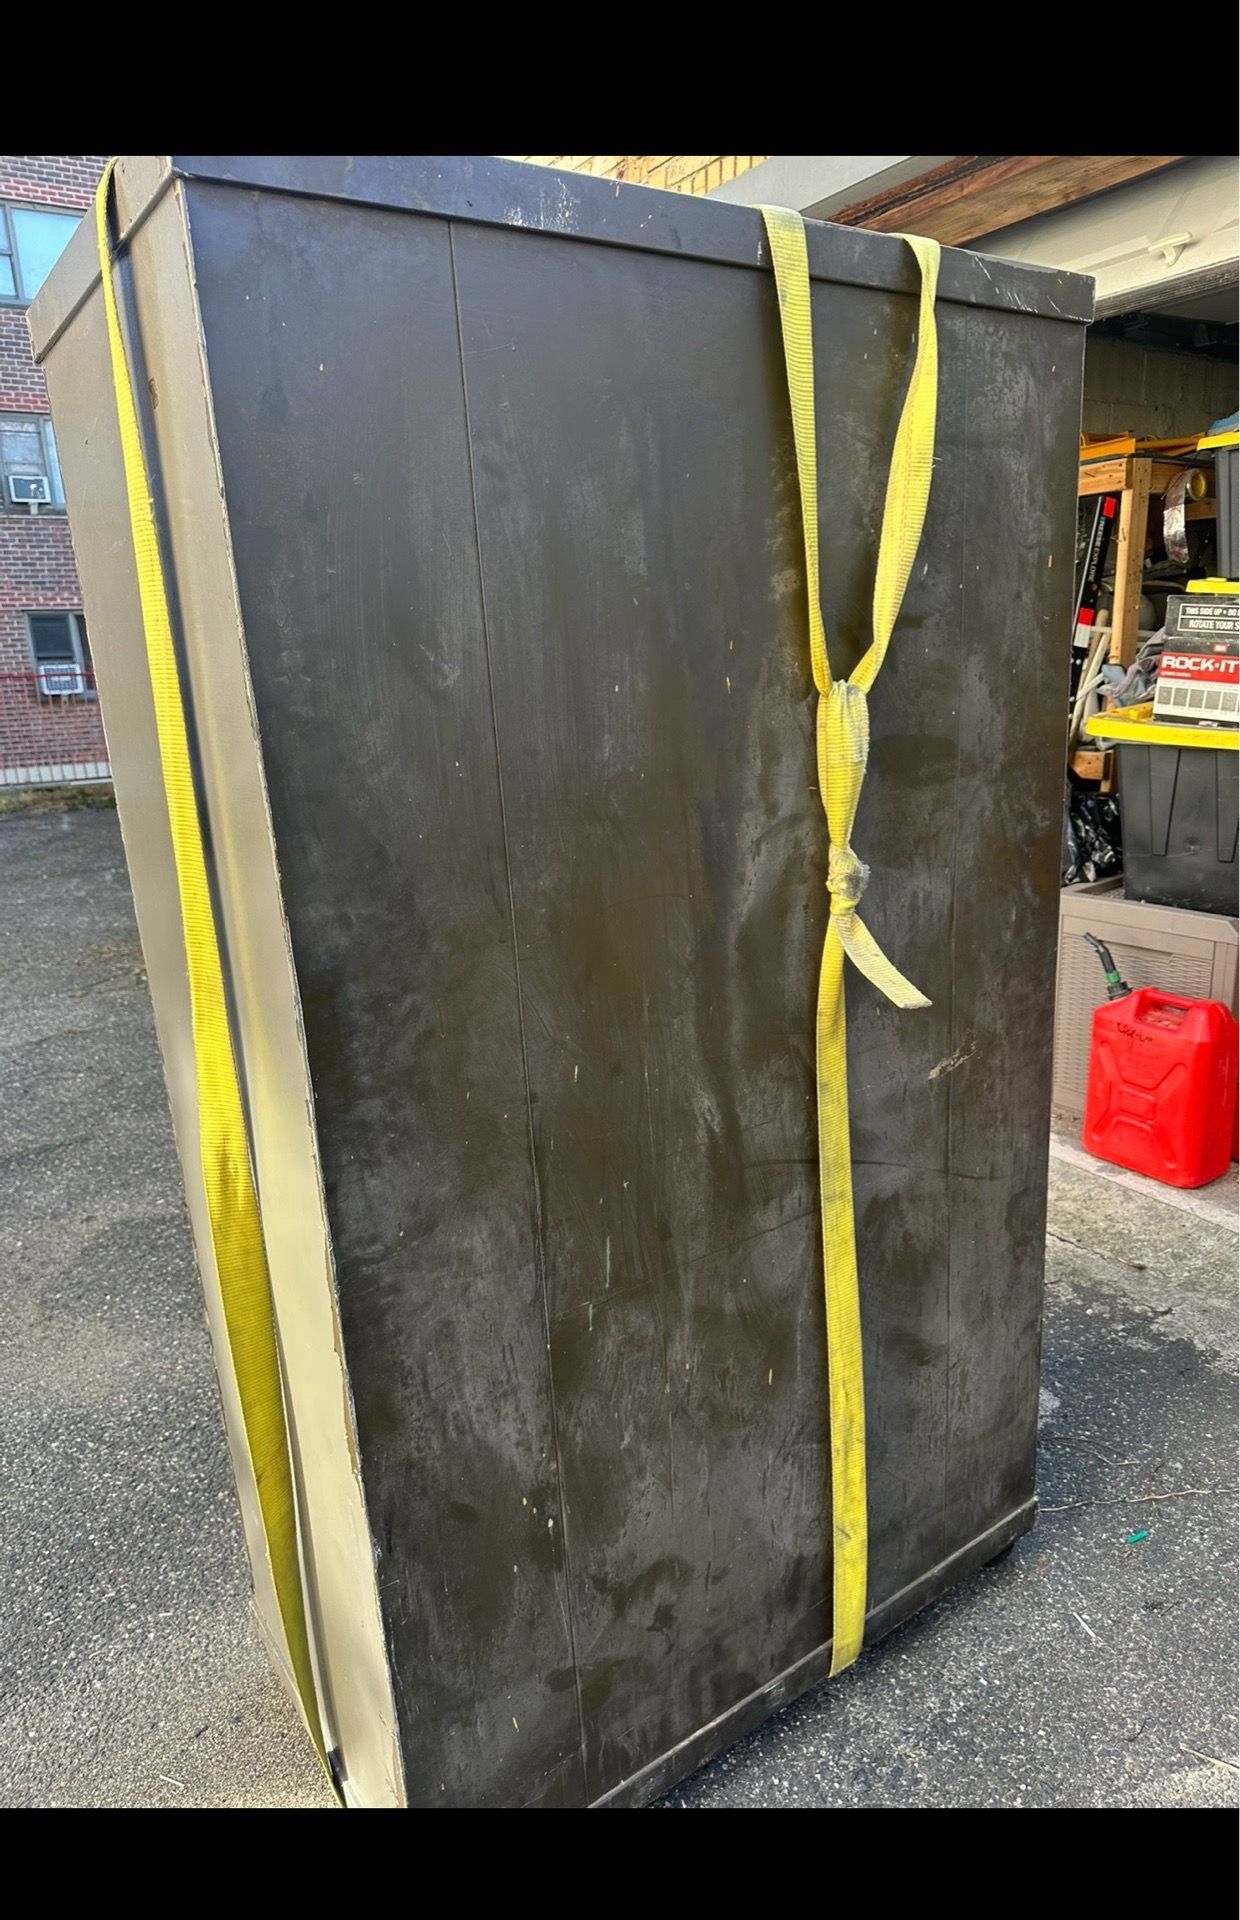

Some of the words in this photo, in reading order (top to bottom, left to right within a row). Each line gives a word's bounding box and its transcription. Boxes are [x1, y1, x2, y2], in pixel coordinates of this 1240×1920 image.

[1185, 607, 1199, 615] THIS
[1199, 607, 1213, 616] SIDE
[1213, 608, 1222, 616] UP
[1227, 608, 1237, 616] DO
[1188, 619, 1214, 629] ROTATE
[1215, 620, 1234, 630] YOUR
